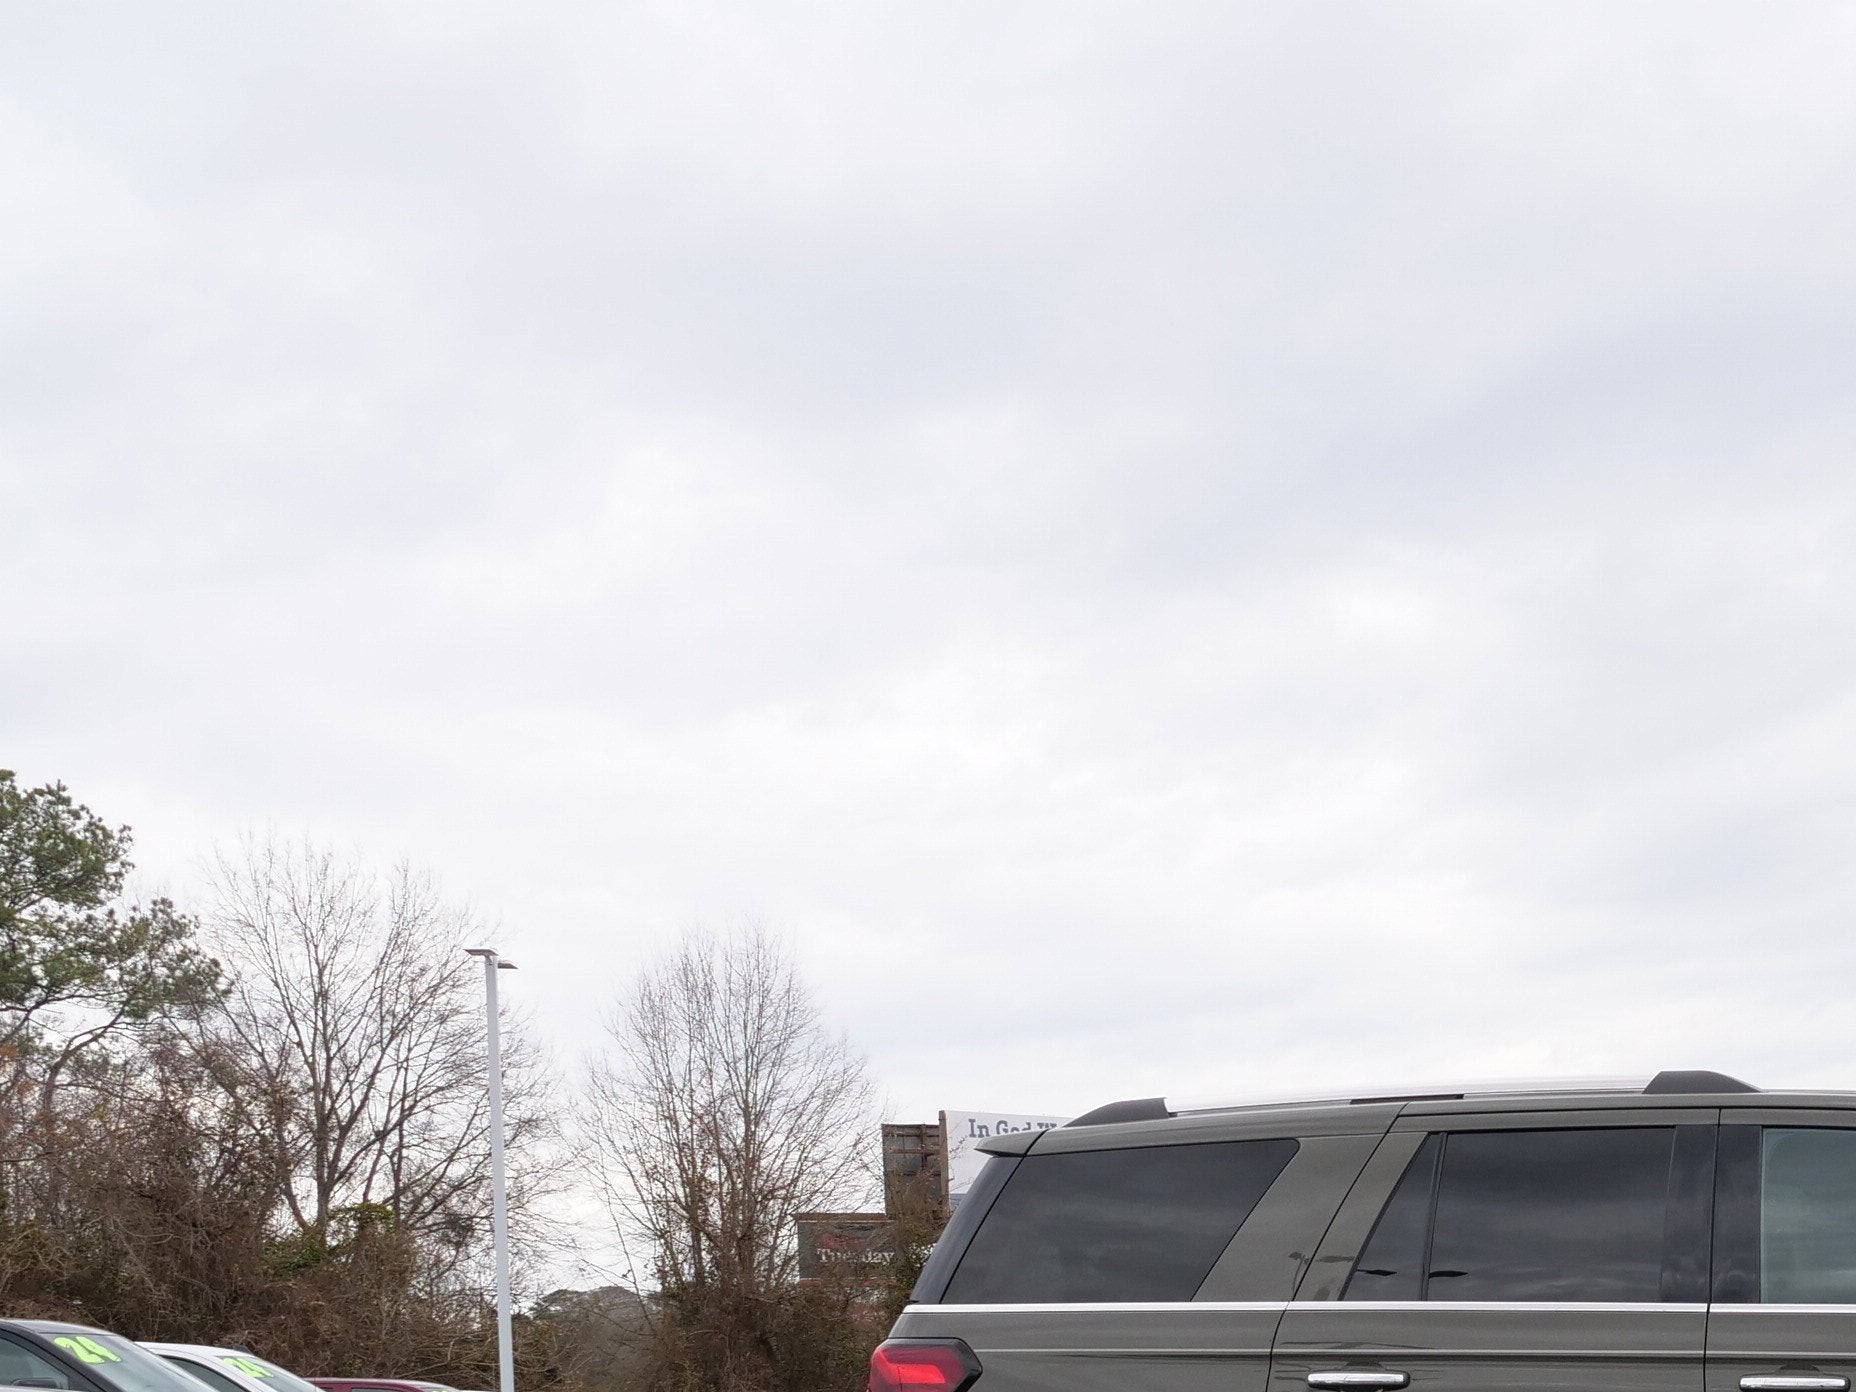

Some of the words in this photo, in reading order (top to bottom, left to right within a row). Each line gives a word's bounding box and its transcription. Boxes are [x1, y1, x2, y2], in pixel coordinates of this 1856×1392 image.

[968, 1118, 990, 1138] In
[54, 1336, 122, 1363] 24
[223, 1357, 274, 1378] 24
